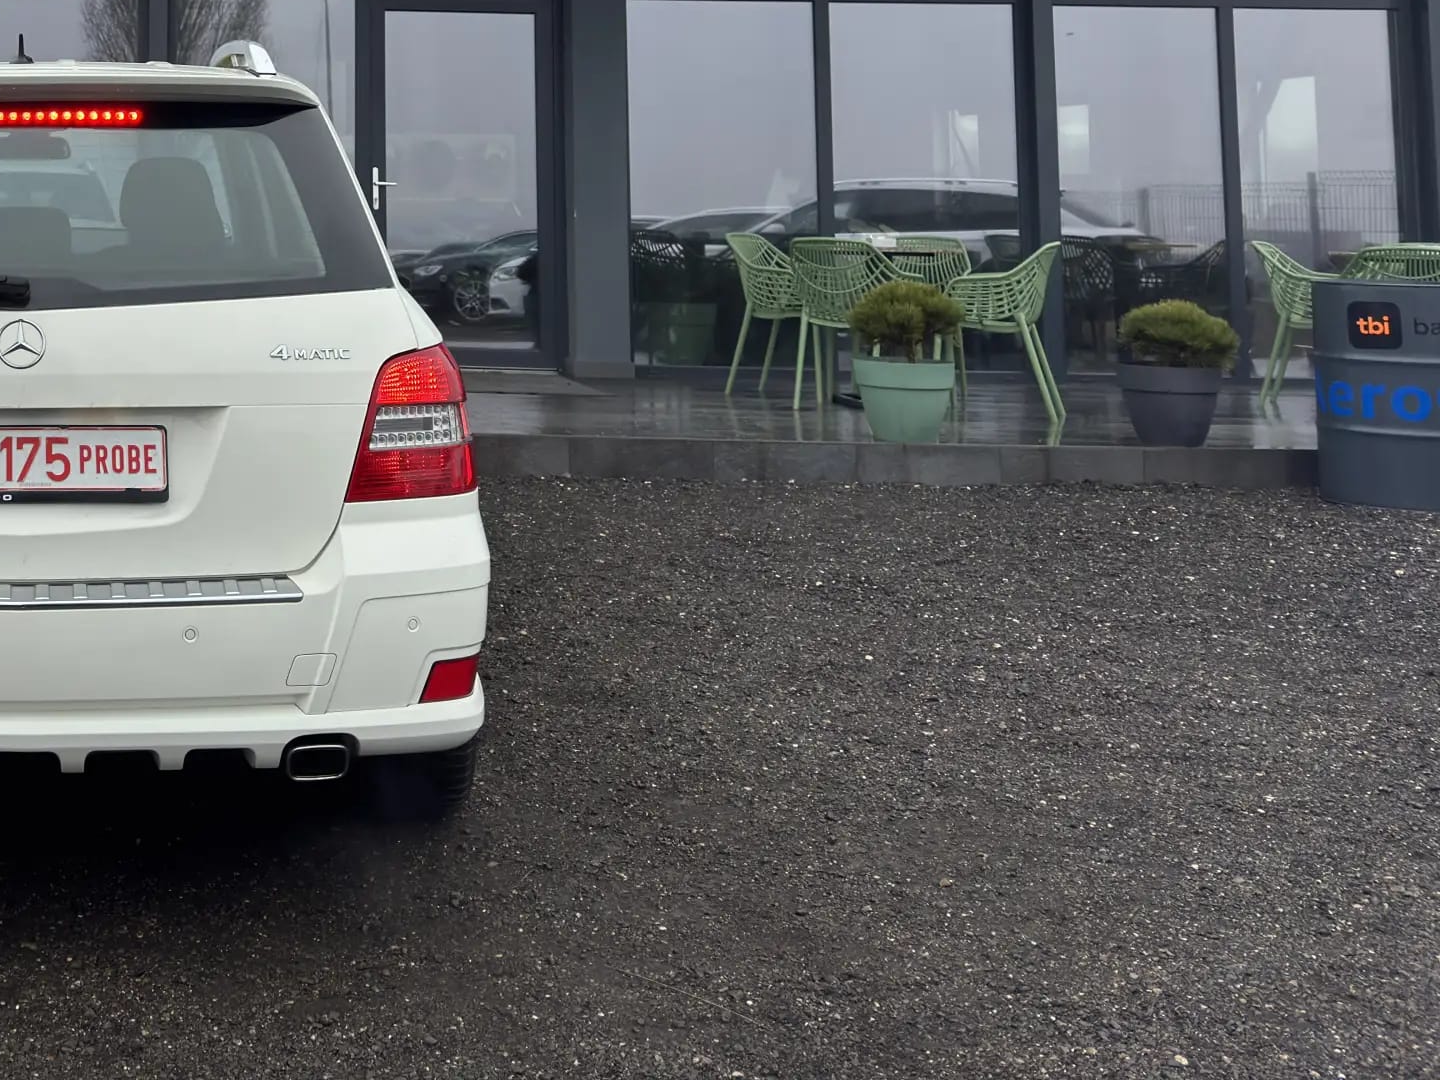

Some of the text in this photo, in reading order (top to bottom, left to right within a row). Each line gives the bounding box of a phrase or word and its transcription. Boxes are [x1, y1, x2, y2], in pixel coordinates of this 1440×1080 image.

[1356, 315, 1390, 335] tbi
[1315, 366, 1440, 423] ero
[0, 436, 72, 483] 175
[79, 444, 158, 475] PROBE
